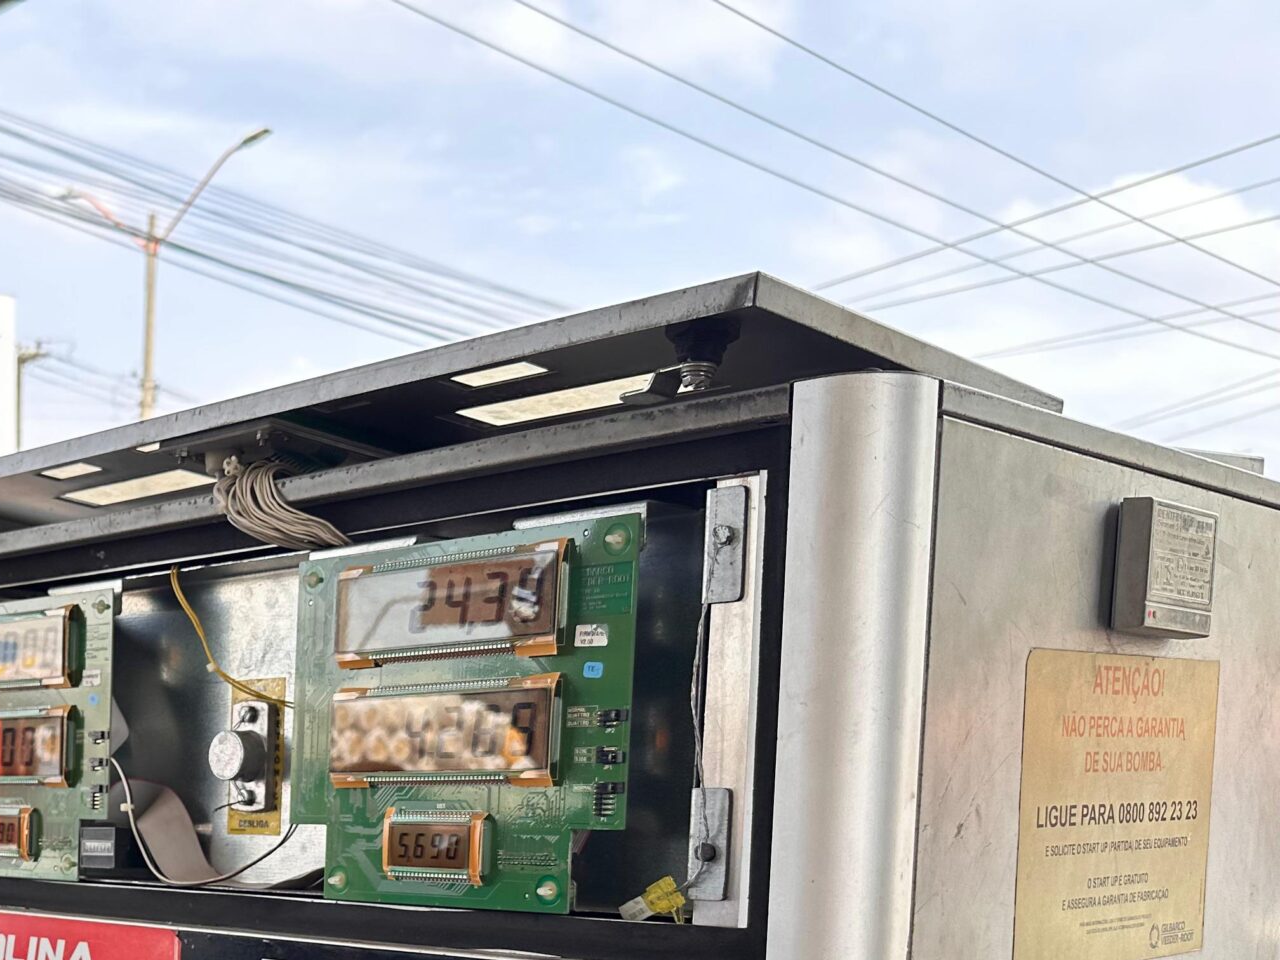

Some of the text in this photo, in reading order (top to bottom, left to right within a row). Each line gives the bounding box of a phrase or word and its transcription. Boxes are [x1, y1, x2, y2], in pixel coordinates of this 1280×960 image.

[1092, 662, 1166, 705] ATENÇÃO!
[1061, 710, 1186, 738] NÃO PERCA A GARANTIA
[1084, 751, 1100, 773] DE
[1102, 751, 1123, 773] SUA
[1036, 800, 1198, 829] LIGUE PARA 0800 892 23 23
[1045, 845, 1050, 857] E
[1050, 843, 1076, 857] SOLICITE
[1076, 844, 1081, 855] O
[1082, 842, 1100, 855] START
[1134, 839, 1142, 850] DE
[1143, 838, 1153, 850] SEU
[1153, 836, 1188, 849] EQUIPAMENTO
[1092, 876, 1110, 889] START
[1123, 872, 1149, 885] GRATUITO
[1066, 897, 1097, 910] ASSEGURA
[1102, 892, 1129, 906] GARANTIA
[1129, 891, 1136, 903] DE
